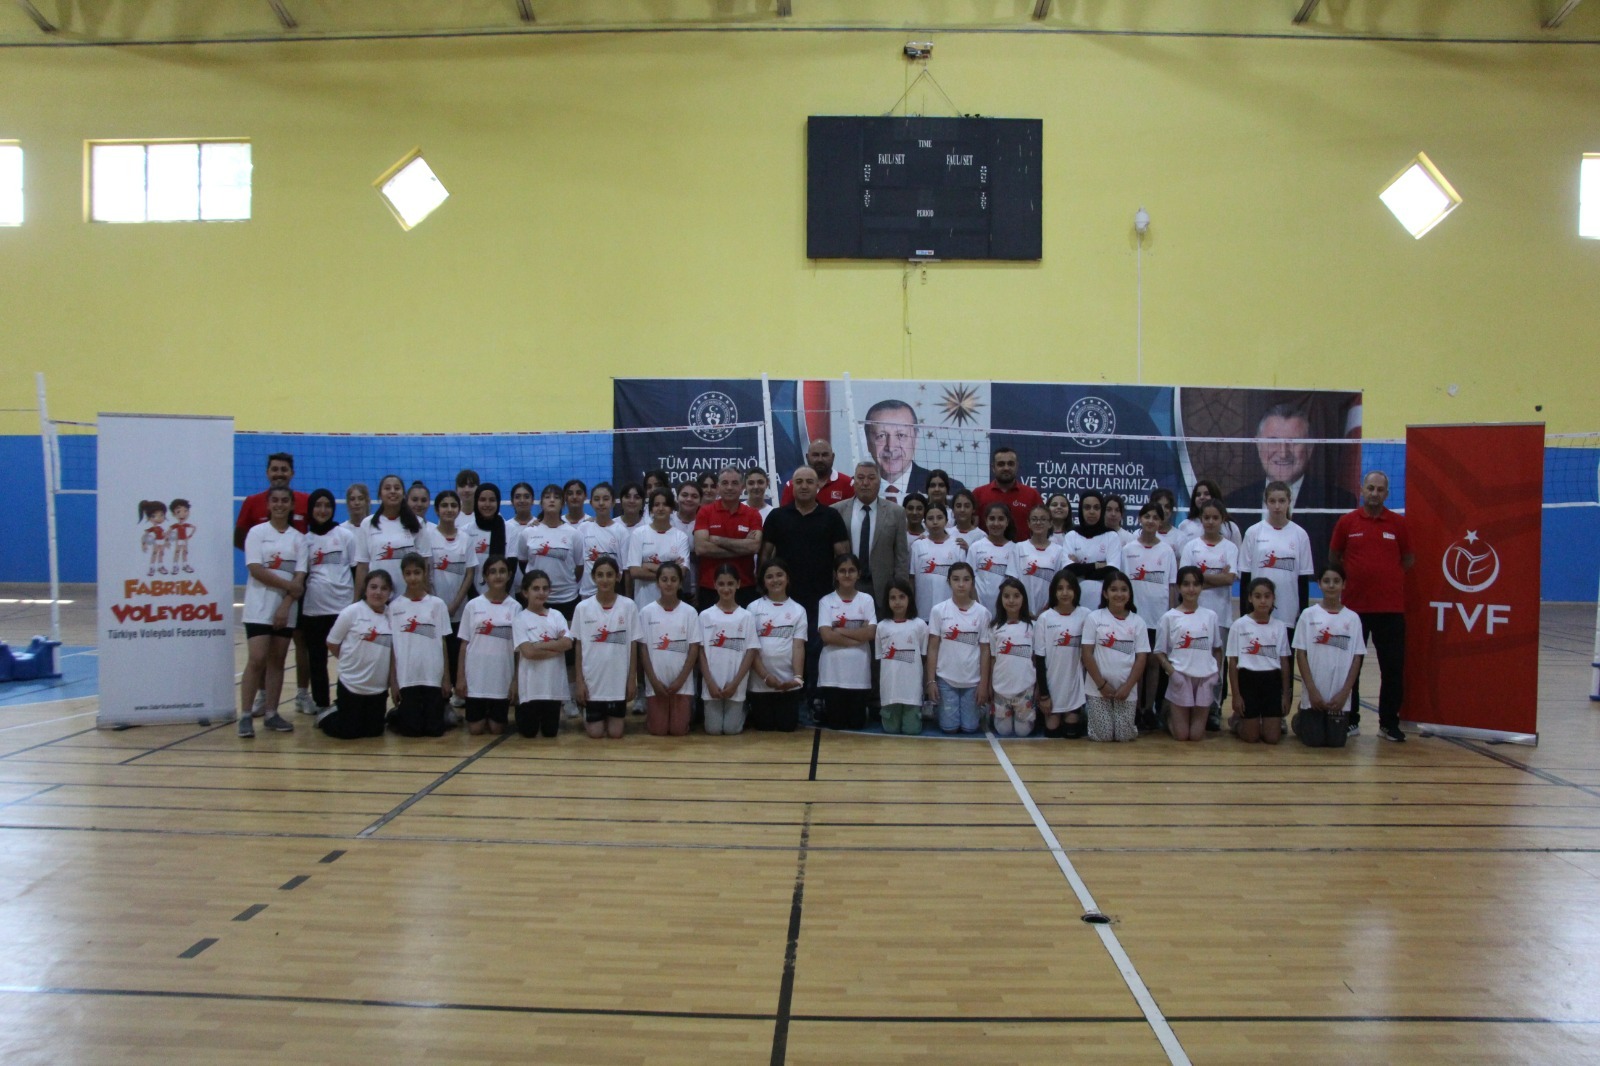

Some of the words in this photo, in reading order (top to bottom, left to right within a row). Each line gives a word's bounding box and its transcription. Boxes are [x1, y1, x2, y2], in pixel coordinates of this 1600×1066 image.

[918, 139, 932, 148] TIME
[658, 455, 689, 470] TÜM
[1036, 460, 1067, 475] TÜM
[1070, 461, 1144, 476] ANTRENÖR
[1020, 476, 1037, 489] VE
[1040, 476, 1159, 491] SPORCULARIMIZA
[111, 602, 223, 624] VOLEYBOL
[1429, 601, 1511, 635] TVF
[108, 629, 138, 640] Türkiye
[140, 628, 174, 639] Voleybol
[176, 627, 226, 639] Federasyonu
